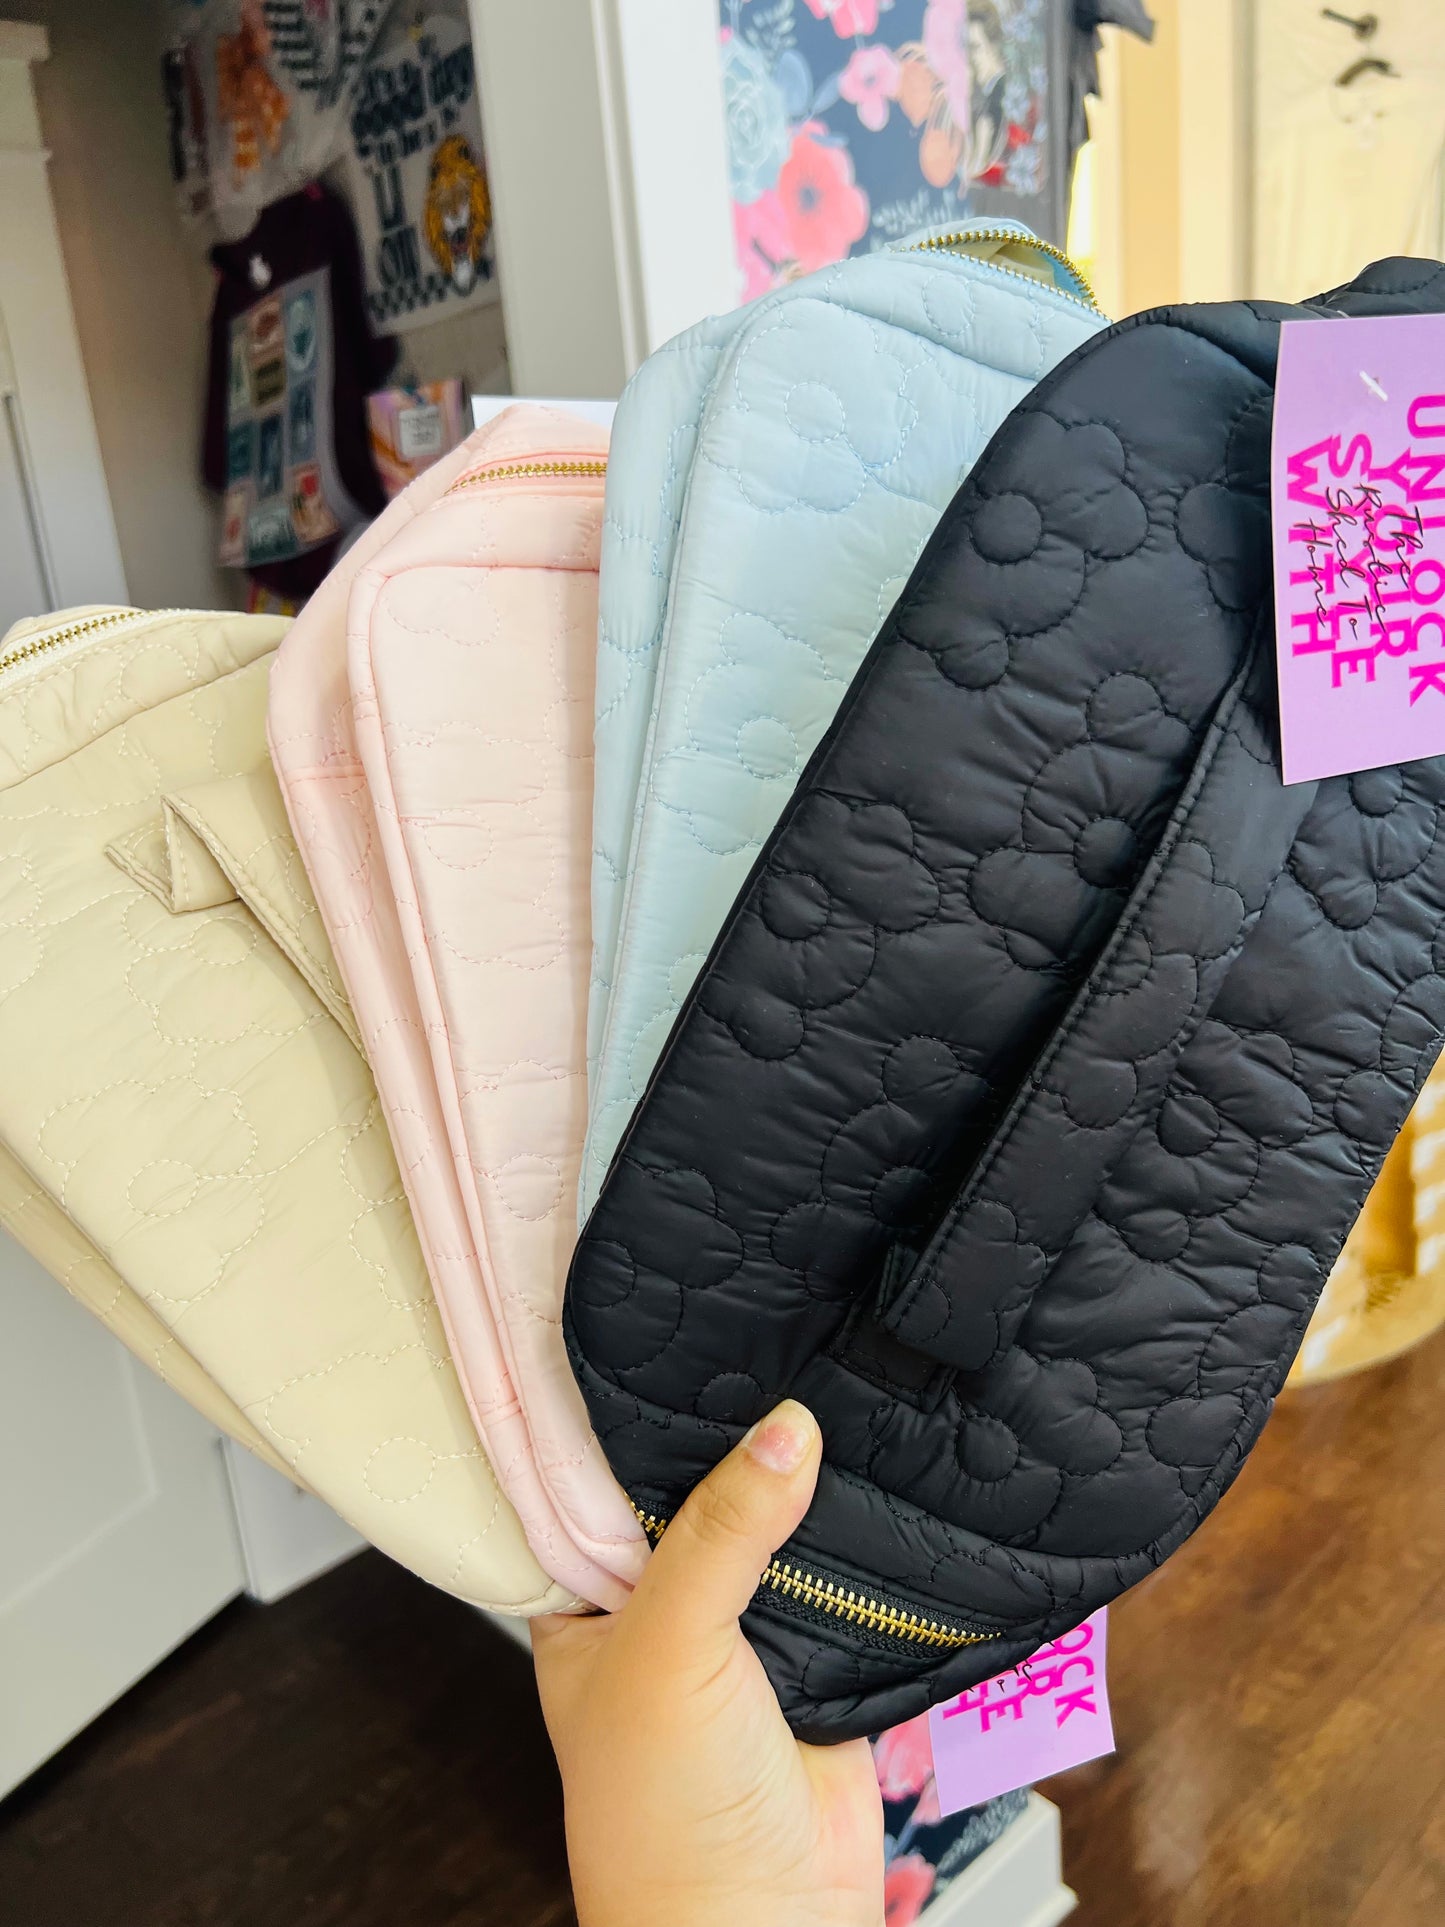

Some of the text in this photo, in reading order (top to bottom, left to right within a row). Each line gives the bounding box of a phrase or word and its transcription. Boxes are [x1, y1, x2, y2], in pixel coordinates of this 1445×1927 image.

[1287, 434, 1336, 658] WITH
[1294, 518, 1334, 627] Home
[1325, 487, 1375, 640] Shed To
[1328, 433, 1377, 689] STYLE
[1353, 482, 1393, 633] Rustic
[1367, 446, 1412, 658] YOUR
[1384, 505, 1424, 589] The
[1407, 394, 1445, 707] UNLOCK
[1052, 1622, 1098, 1730] OCK
